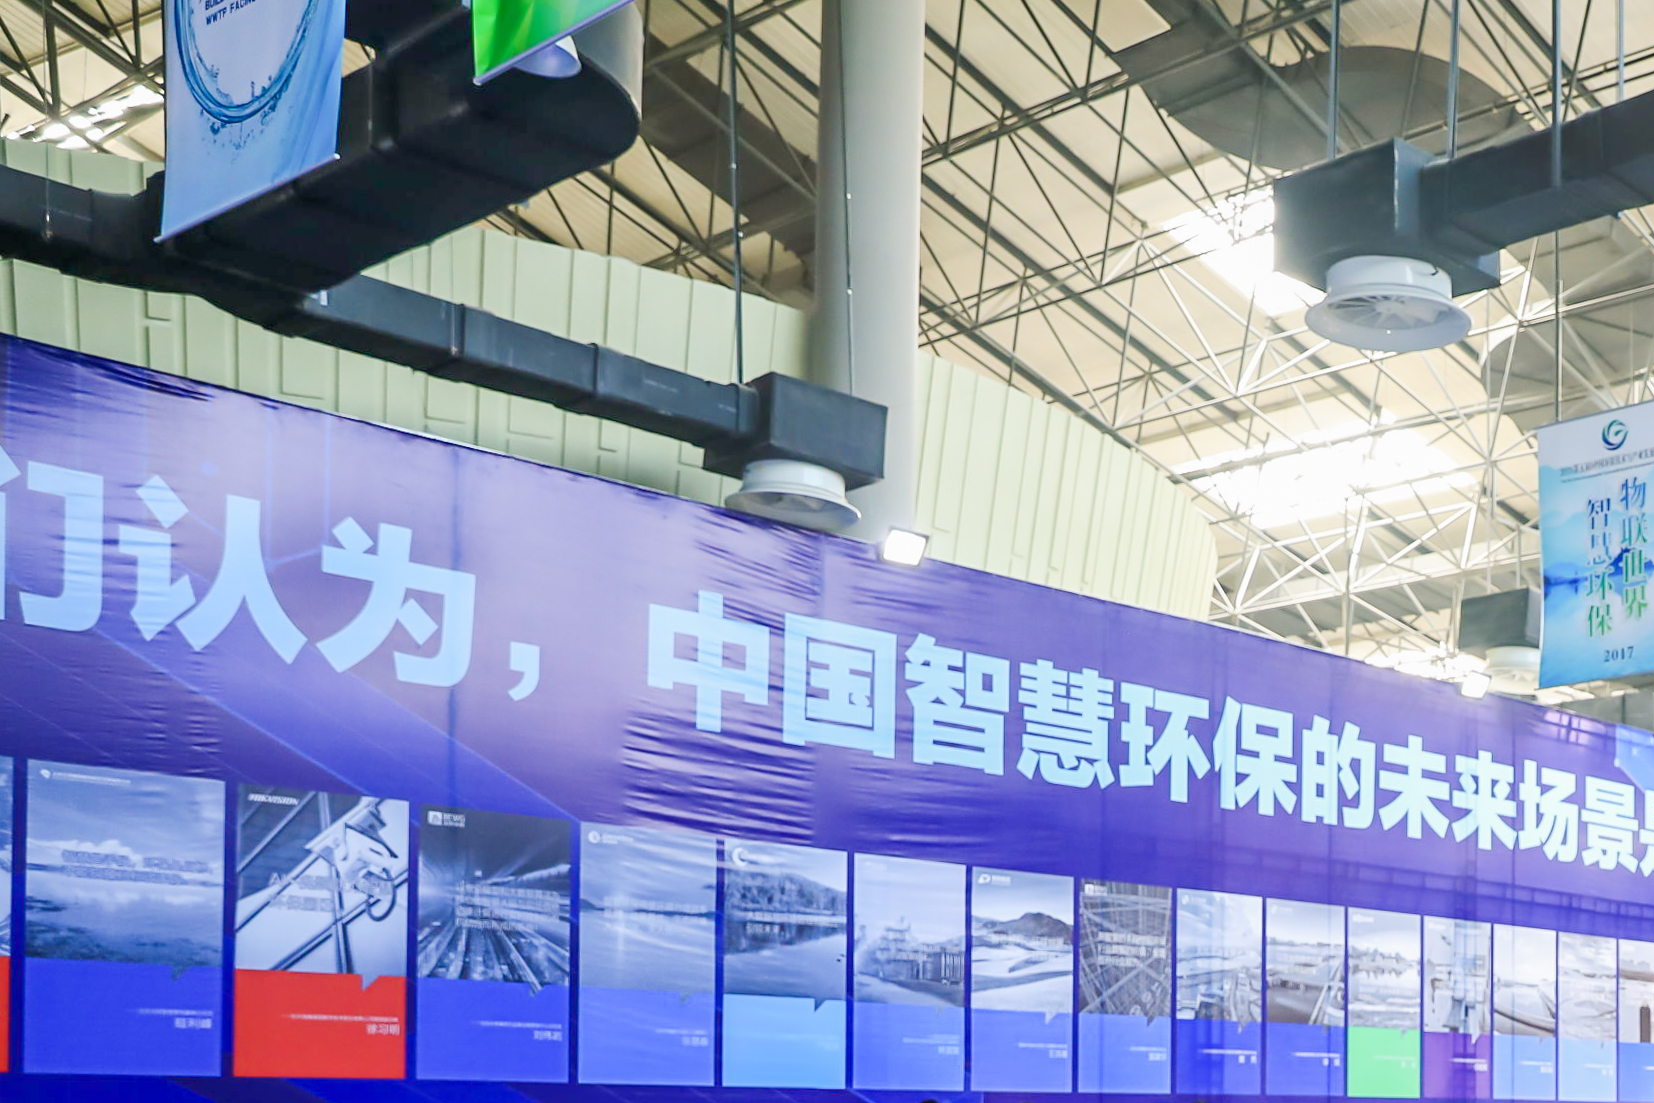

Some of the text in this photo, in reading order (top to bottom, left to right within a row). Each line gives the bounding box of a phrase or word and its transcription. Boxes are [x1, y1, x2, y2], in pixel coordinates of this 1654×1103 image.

[1586, 499, 1613, 638] 智慧环保
[1619, 476, 1648, 620] 物联世界
[1604, 646, 1635, 663] 2017
